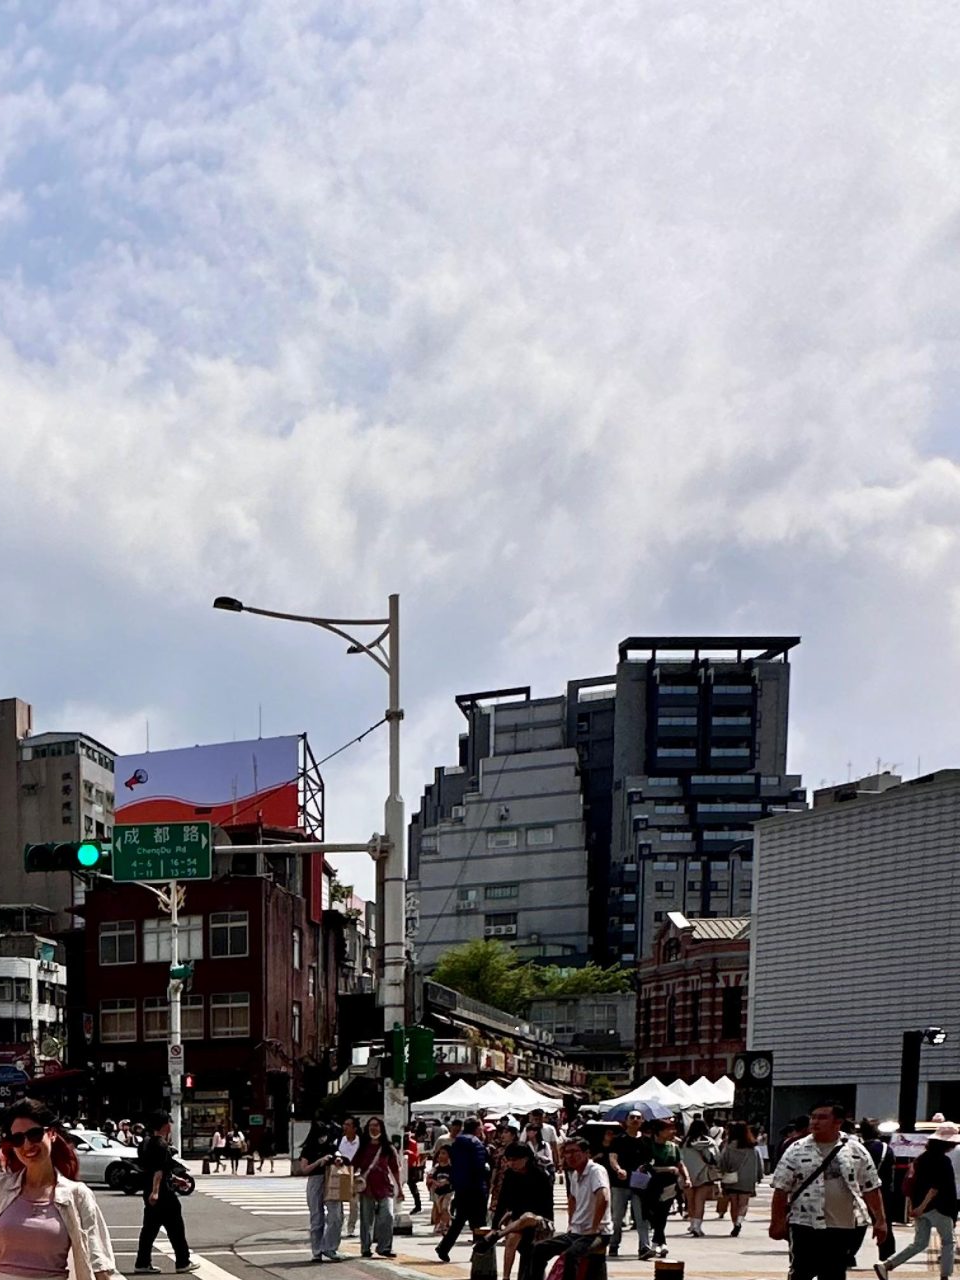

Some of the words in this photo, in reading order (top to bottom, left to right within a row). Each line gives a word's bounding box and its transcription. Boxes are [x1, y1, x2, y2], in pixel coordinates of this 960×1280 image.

[124, 825, 199, 845] 成都路
[175, 845, 187, 853] Rd
